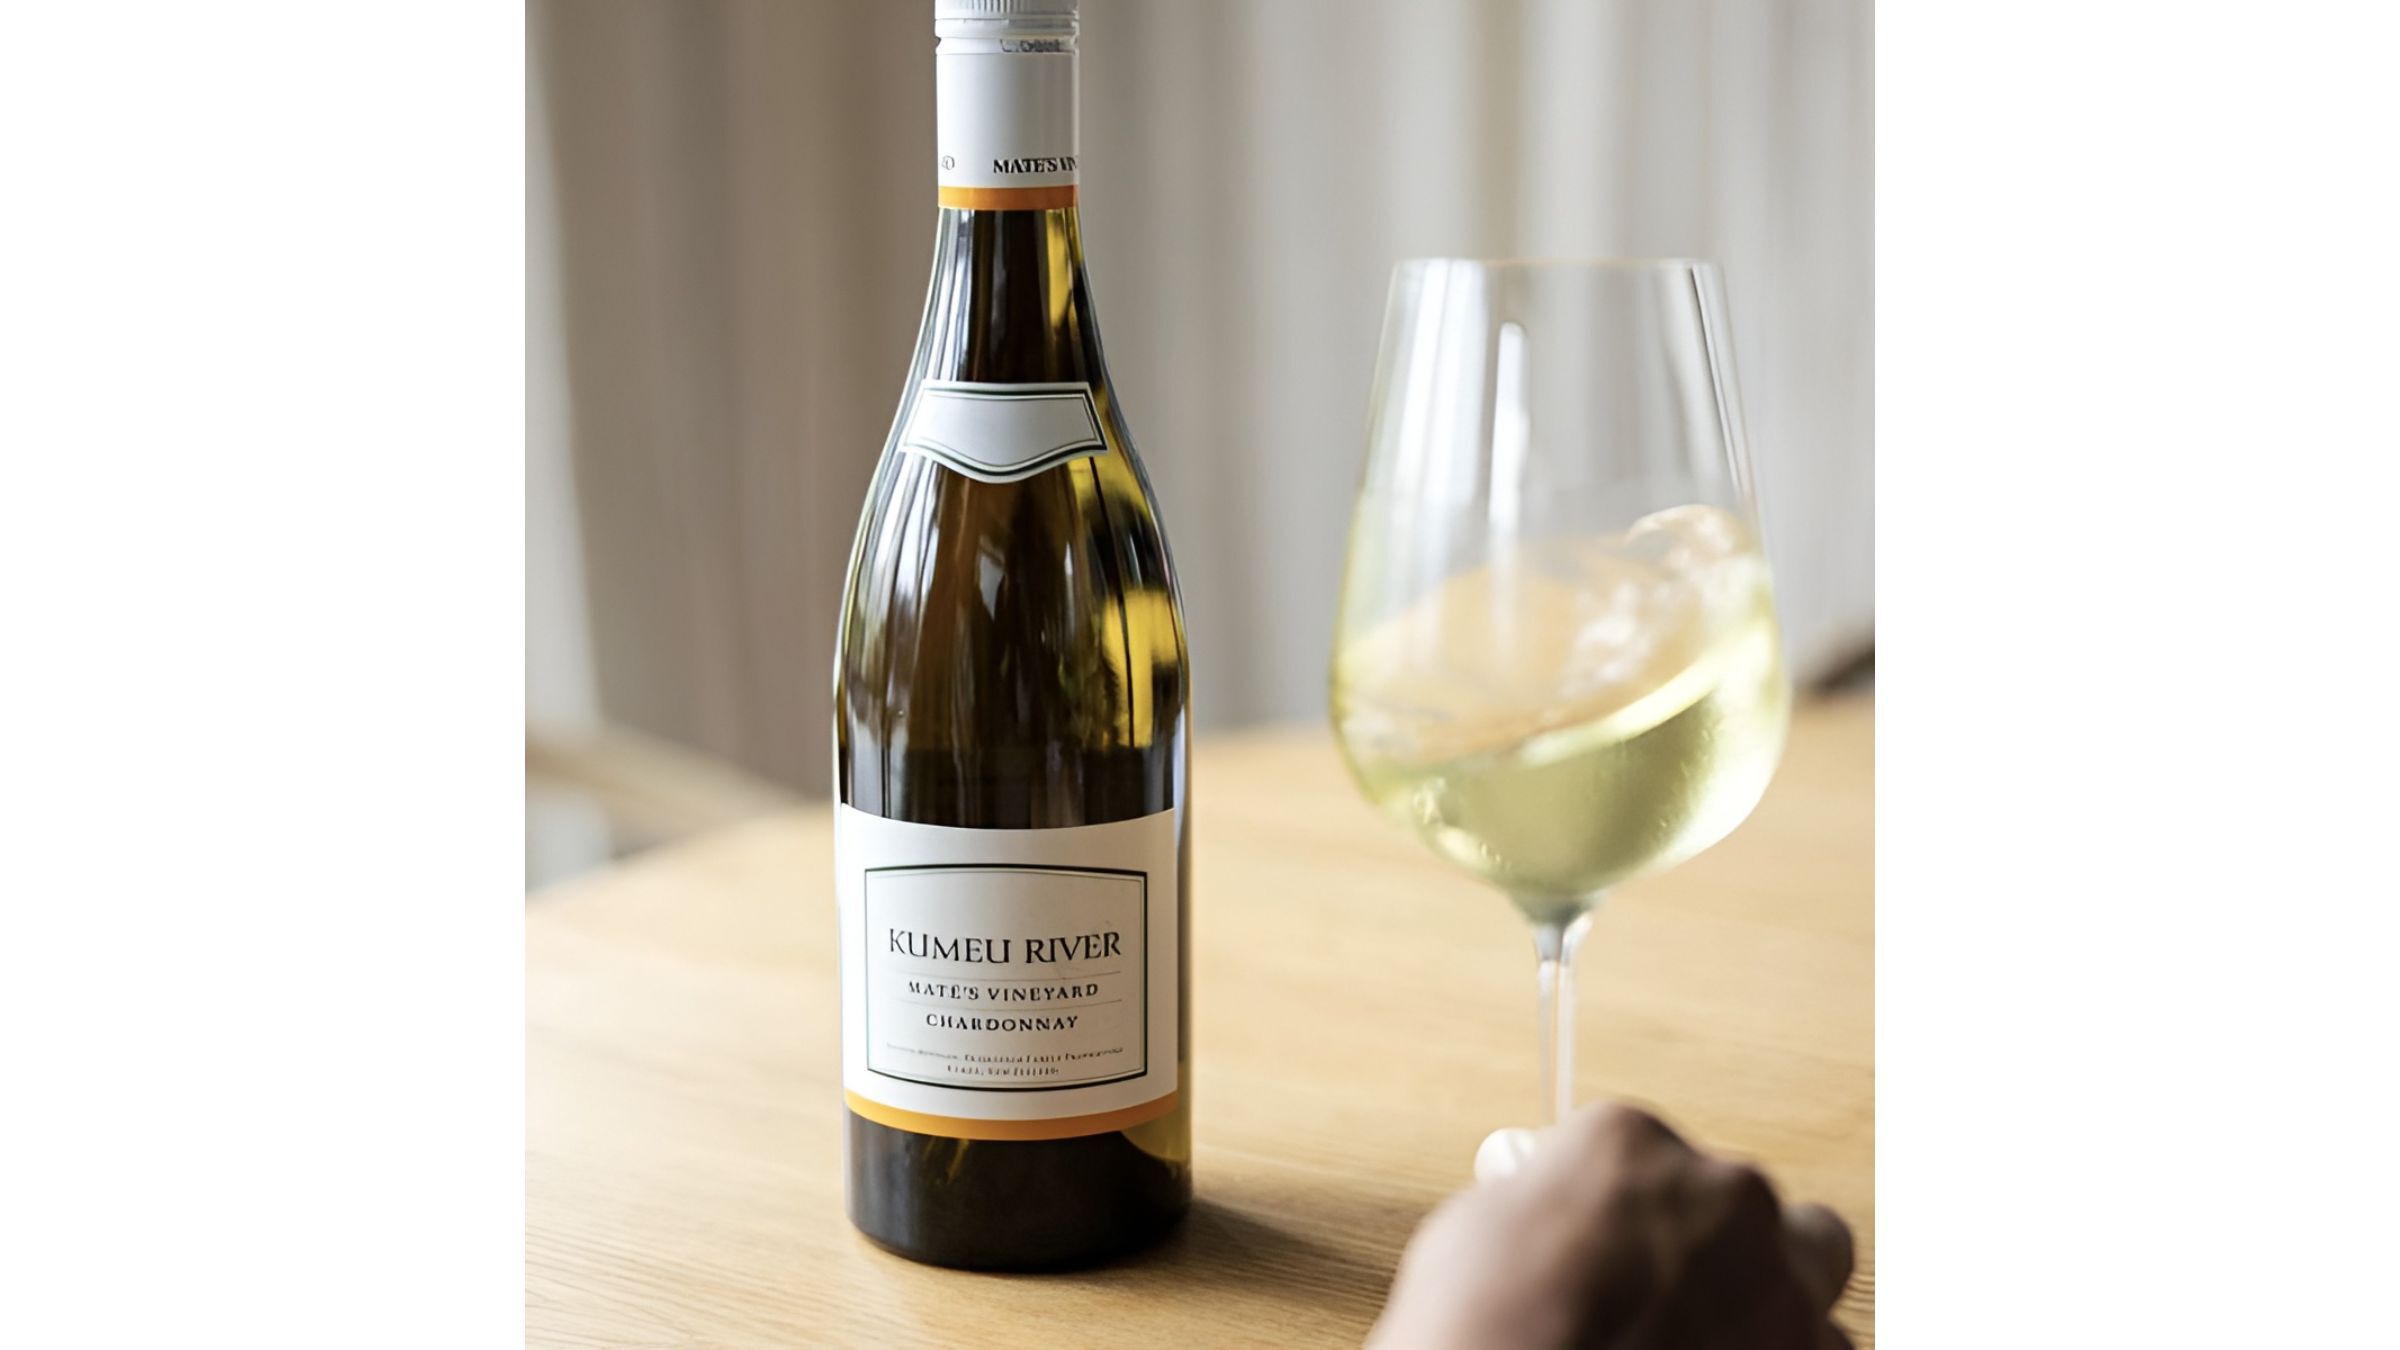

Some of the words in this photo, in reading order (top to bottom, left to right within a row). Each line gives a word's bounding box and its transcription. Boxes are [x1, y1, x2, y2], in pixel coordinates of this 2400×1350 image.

[889, 928, 1011, 964] KUMEU
[1025, 931, 1121, 964] RIVER
[987, 983, 1099, 1002] VINEYARD
[925, 1013, 1079, 1032] CHARDONNAY
